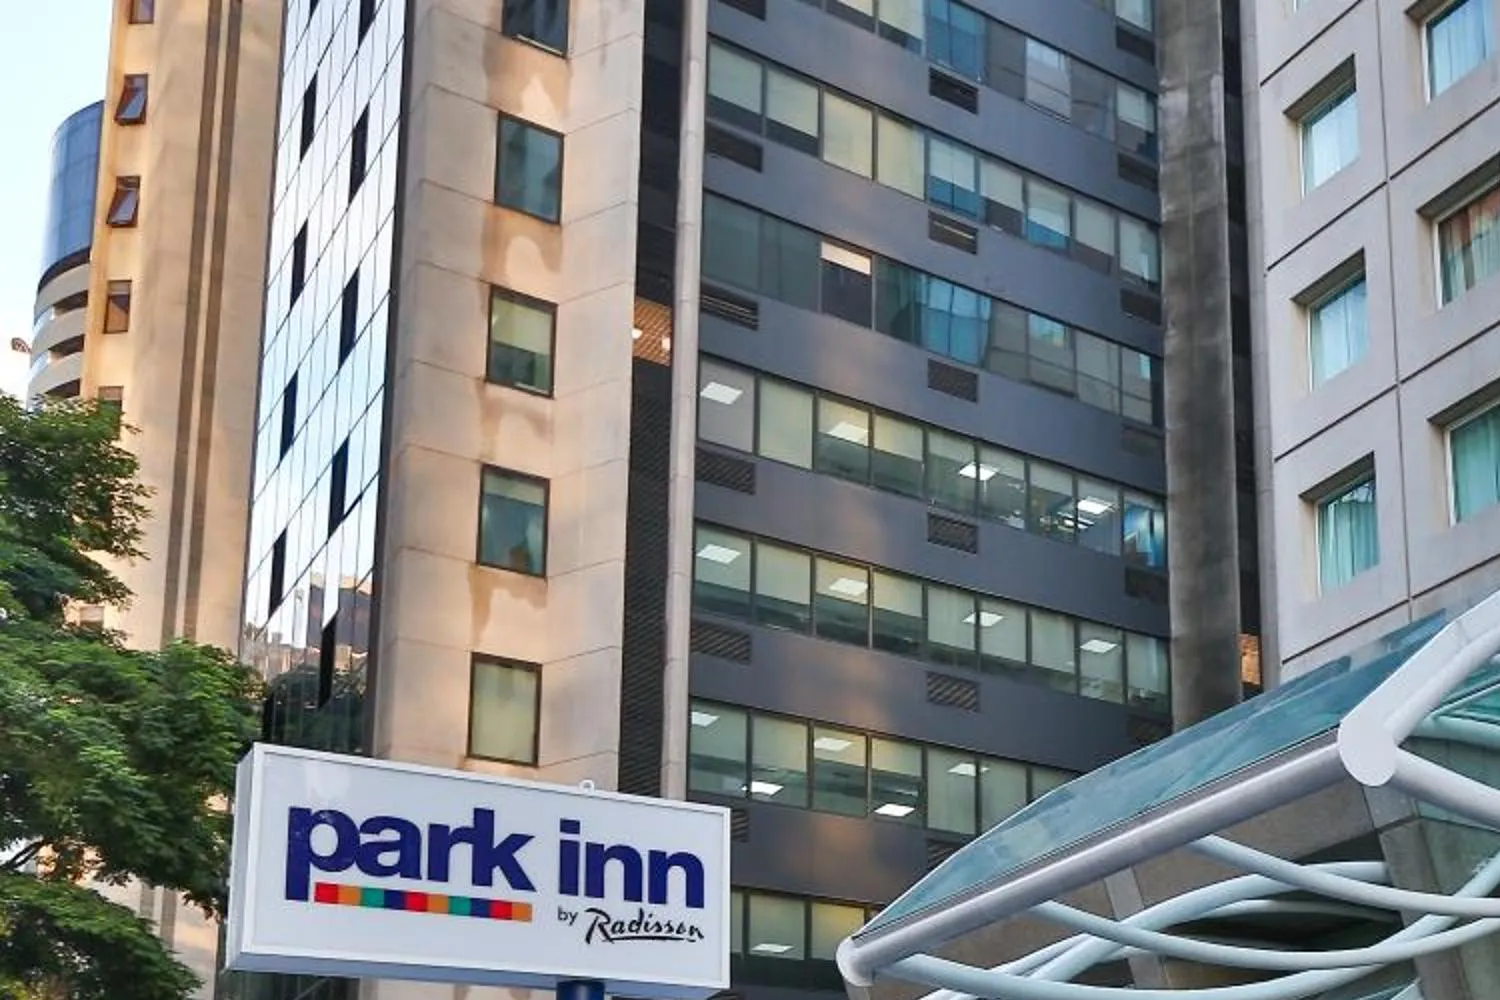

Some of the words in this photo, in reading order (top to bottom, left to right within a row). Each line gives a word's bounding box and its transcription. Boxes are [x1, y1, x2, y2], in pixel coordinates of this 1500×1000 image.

[285, 806, 536, 901] park
[559, 817, 705, 908] inn
[557, 906, 579, 926] by
[584, 906, 705, 945] Radisson
